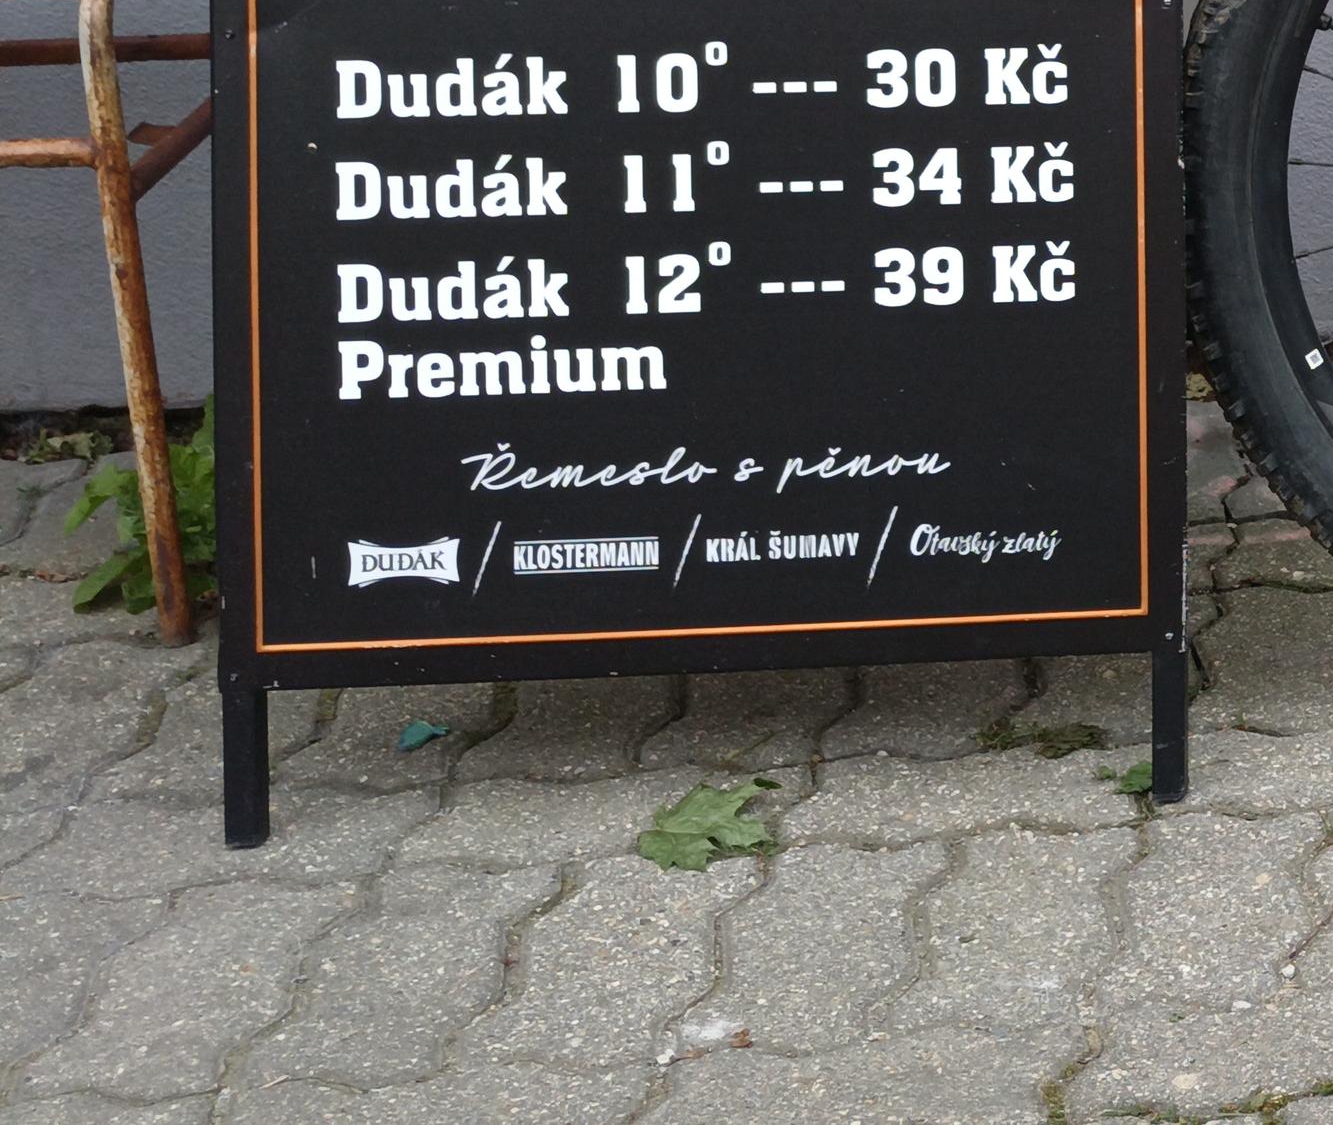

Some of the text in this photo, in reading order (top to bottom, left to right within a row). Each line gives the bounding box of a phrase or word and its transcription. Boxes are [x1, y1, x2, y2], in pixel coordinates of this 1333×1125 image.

[336, 53, 569, 119] Dudák
[866, 48, 957, 109] 30
[984, 43, 1069, 106] Kč
[336, 154, 569, 221] Dudák
[872, 147, 962, 208] 34
[990, 141, 1074, 204] Kč
[337, 255, 570, 324] Dudák
[874, 246, 964, 307] 39
[992, 240, 1076, 303] Kč
[337, 334, 668, 400] Premium
[460, 442, 952, 494] Řemeslo s pěnou
[360, 549, 447, 572] DUDÁK
[513, 540, 660, 571] KLOSTERMANN
[705, 530, 860, 563] KRÁL ŠUMAVY
[1001, 529, 1062, 561] zlatý
